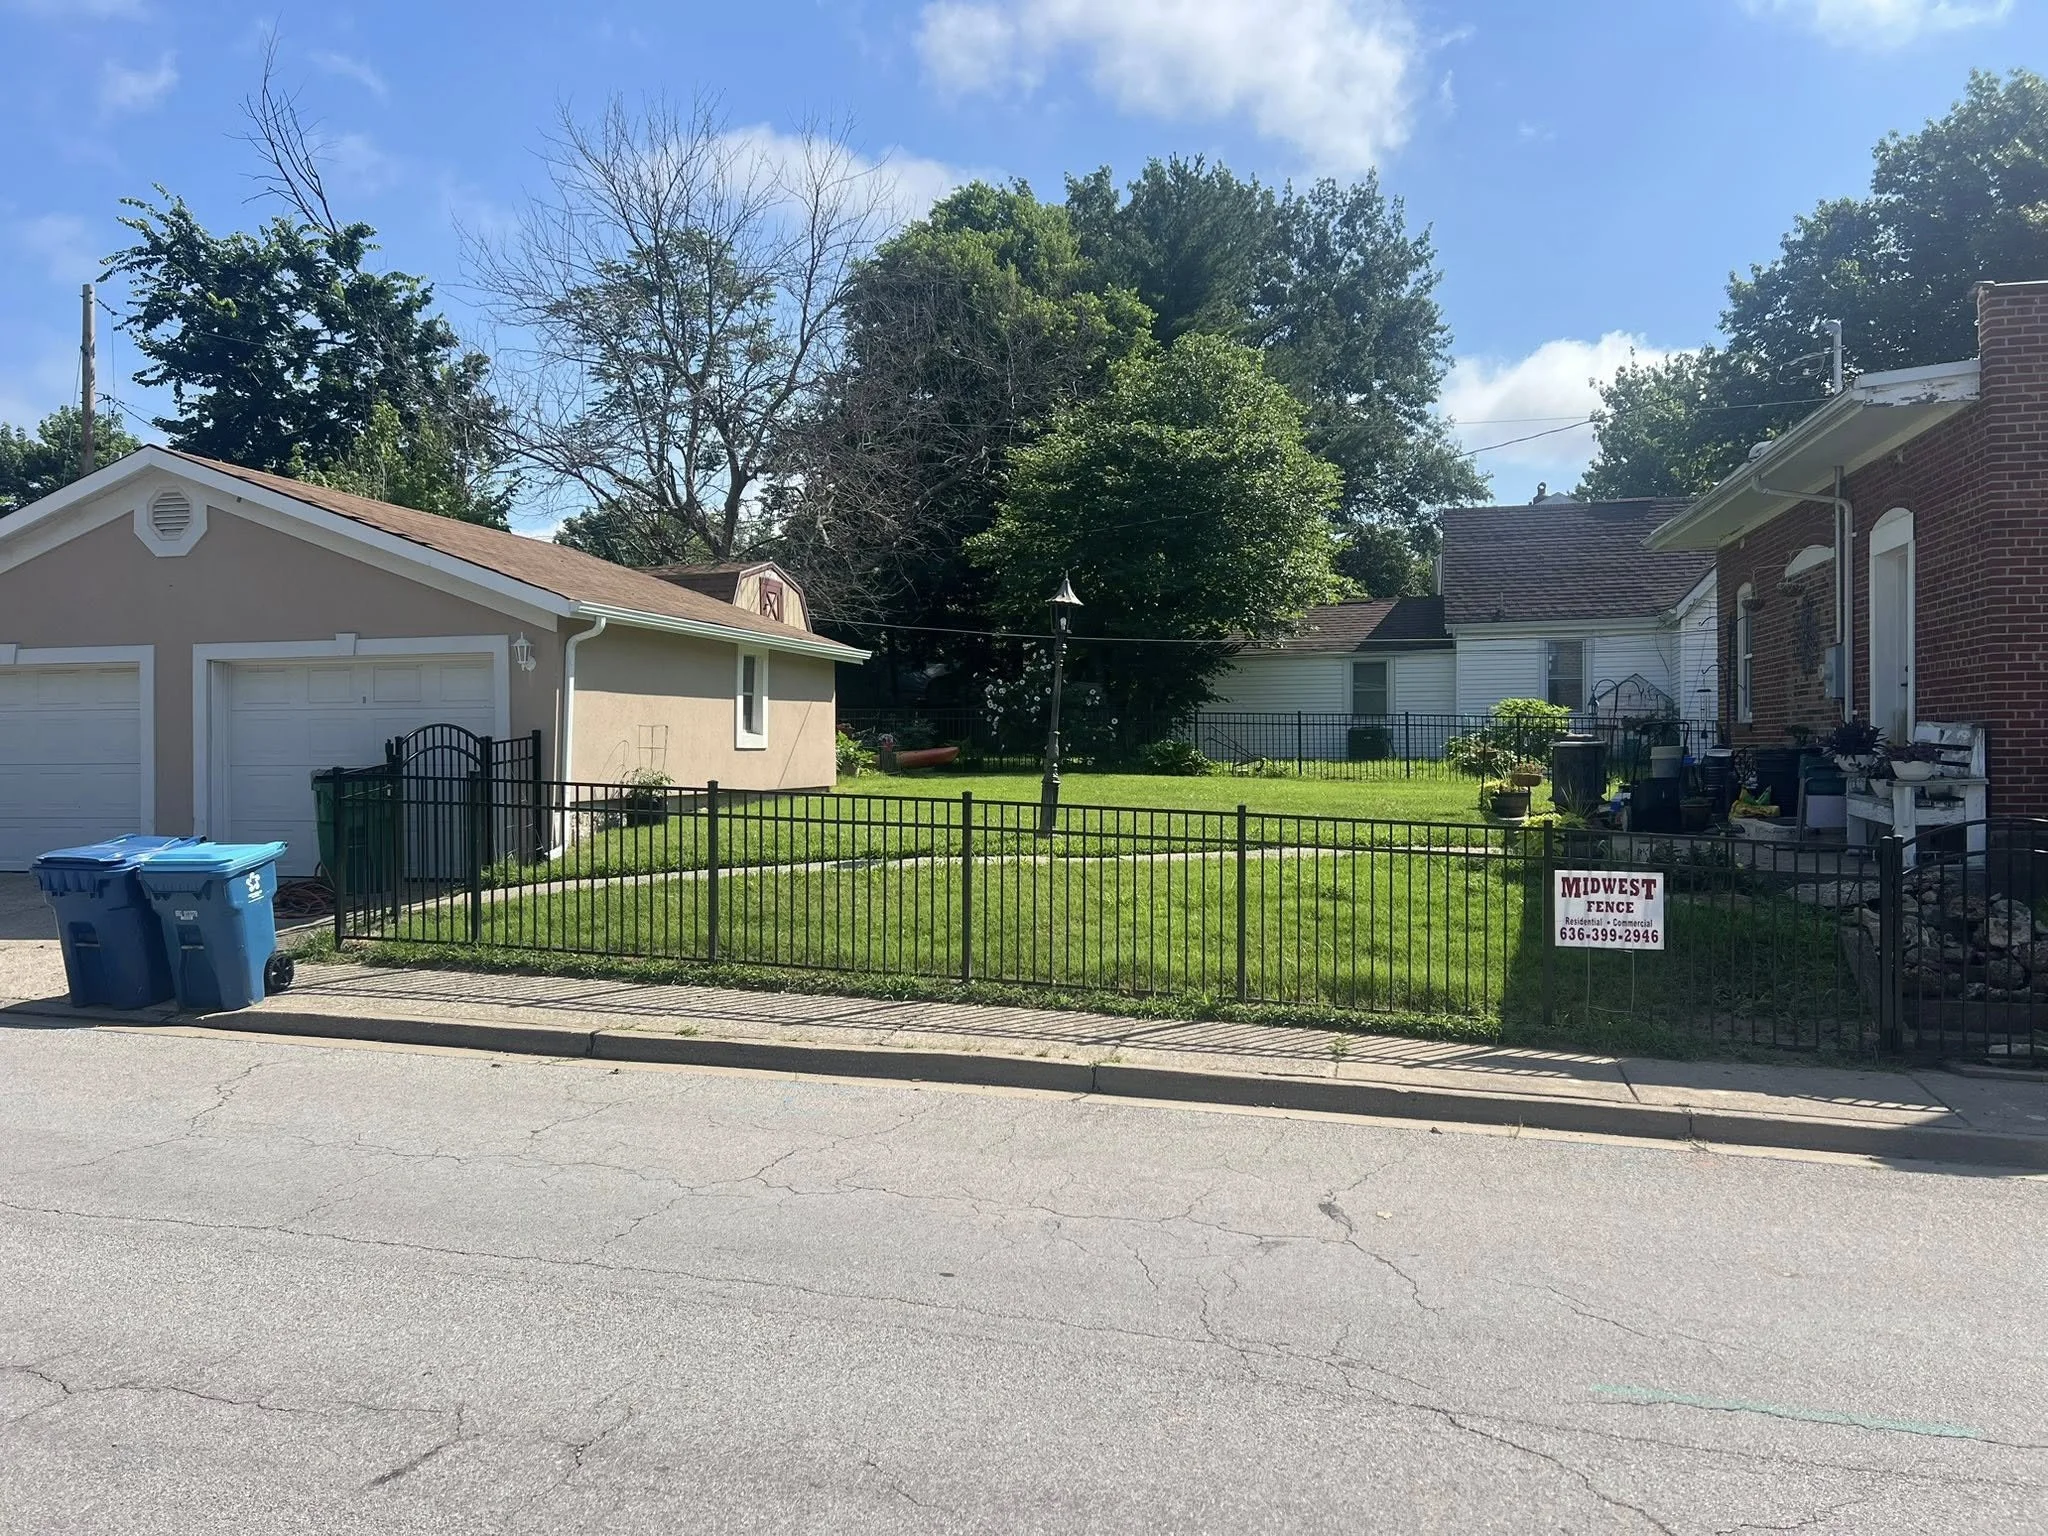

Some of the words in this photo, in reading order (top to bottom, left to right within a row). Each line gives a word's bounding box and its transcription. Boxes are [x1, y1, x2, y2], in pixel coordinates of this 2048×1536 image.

[1561, 876, 1657, 900] MIDWEST
[1586, 901, 1634, 913] FENCE
[1565, 916, 1603, 926] Residential
[1612, 918, 1653, 928] Commercial
[1560, 927, 1659, 943] 636-399-2946
